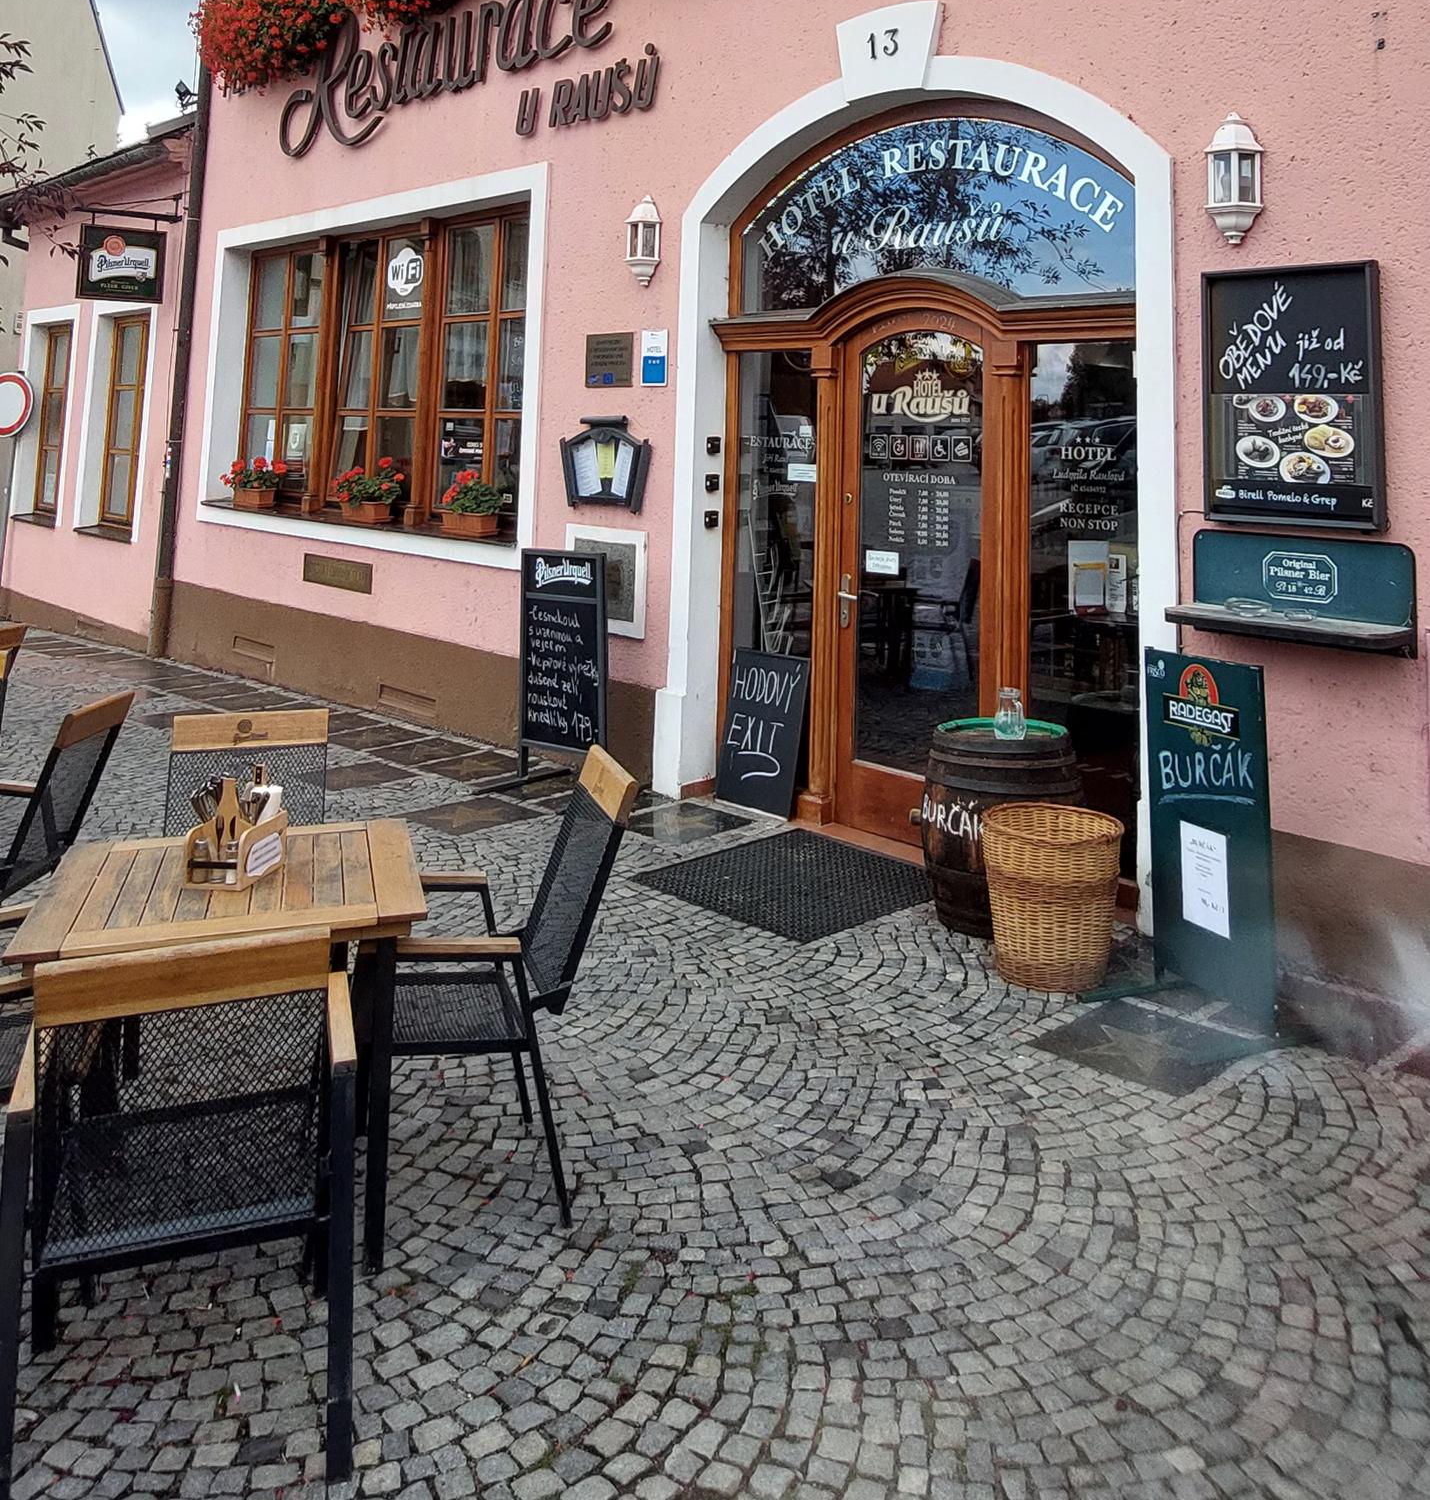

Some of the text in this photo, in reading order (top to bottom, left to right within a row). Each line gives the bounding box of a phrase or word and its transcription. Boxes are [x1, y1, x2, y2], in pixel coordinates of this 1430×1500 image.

[866, 28, 899, 60] 13
[515, 43, 661, 136] U RAUŠŮ
[760, 166, 861, 261] HOTEL
[880, 139, 1124, 233] RESTAURACE
[864, 202, 1004, 251] Raušů
[97, 255, 150, 273] Pilsner Urquell
[1219, 281, 1293, 380] OBĚDOVÉ
[1296, 328, 1345, 361] již od
[1236, 330, 1287, 390] MENU
[913, 379, 942, 397] HOTEL
[891, 385, 971, 423] Raušů
[742, 435, 812, 450] ESTAURACE
[1061, 446, 1116, 460] HOTEL
[883, 472, 956, 485] OTEVÍRACÍ DOBA
[1060, 503, 1118, 516] RECEPCE
[1238, 489, 1264, 500] Birell
[1267, 491, 1301, 503] Pomelo
[1302, 495, 1309, 505] &
[1311, 496, 1337, 511] Grep
[1361, 499, 1374, 508] Kč
[1060, 518, 1118, 531] NON STOP
[535, 557, 564, 588] Pilsner
[1269, 566, 1331, 580] Pilsner Bier
[1282, 558, 1316, 569] Original
[575, 634, 584, 645] a
[733, 664, 801, 714] HODOVÝ
[1169, 700, 1234, 733] RADEGAST
[727, 713, 784, 754] EXIT
[1159, 741, 1254, 790] BURČÁK
